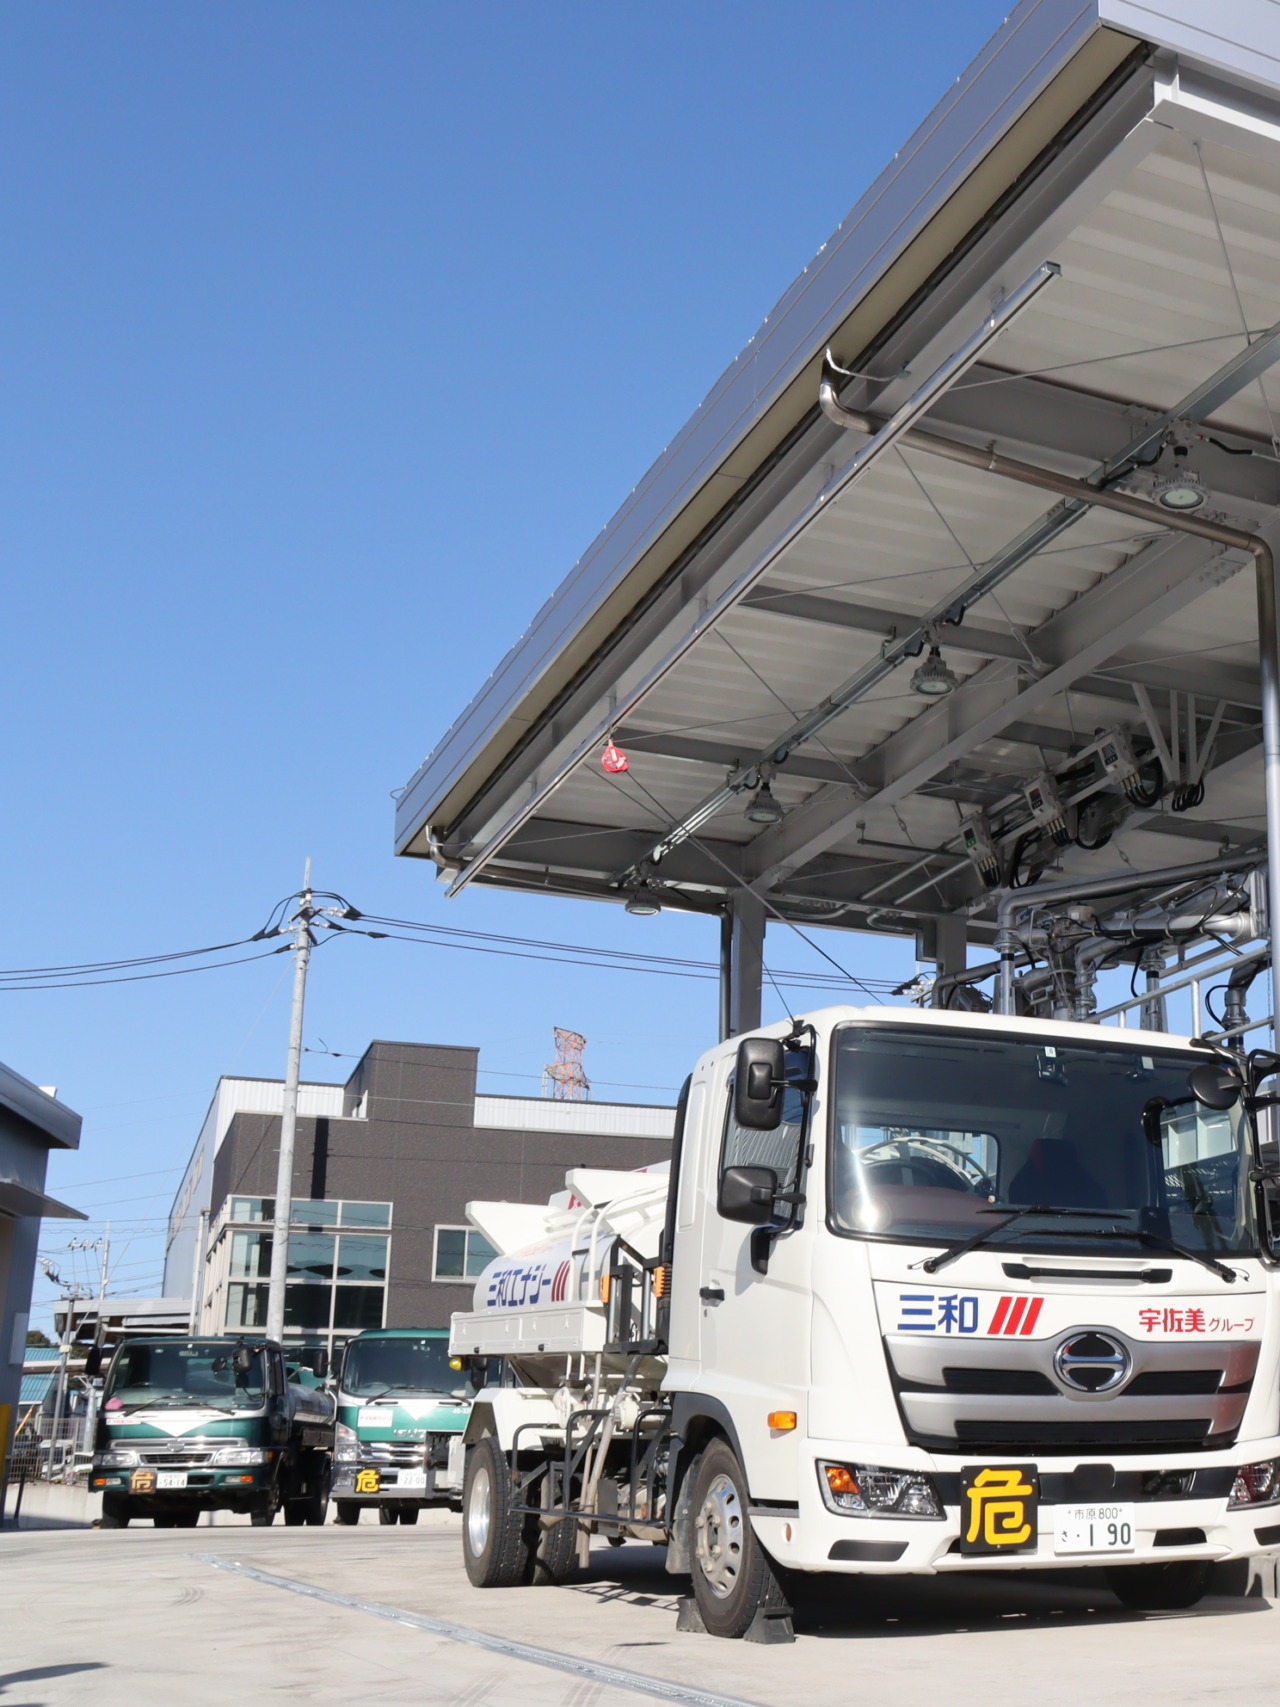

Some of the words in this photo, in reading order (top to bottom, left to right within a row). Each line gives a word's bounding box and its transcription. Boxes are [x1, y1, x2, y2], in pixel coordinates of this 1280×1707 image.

[487, 1263, 552, 1308] 三和エナジー
[897, 1294, 979, 1335] 三和
[131, 1469, 155, 1492] 危
[356, 1469, 379, 1492] 危
[966, 1469, 1033, 1546] 危
